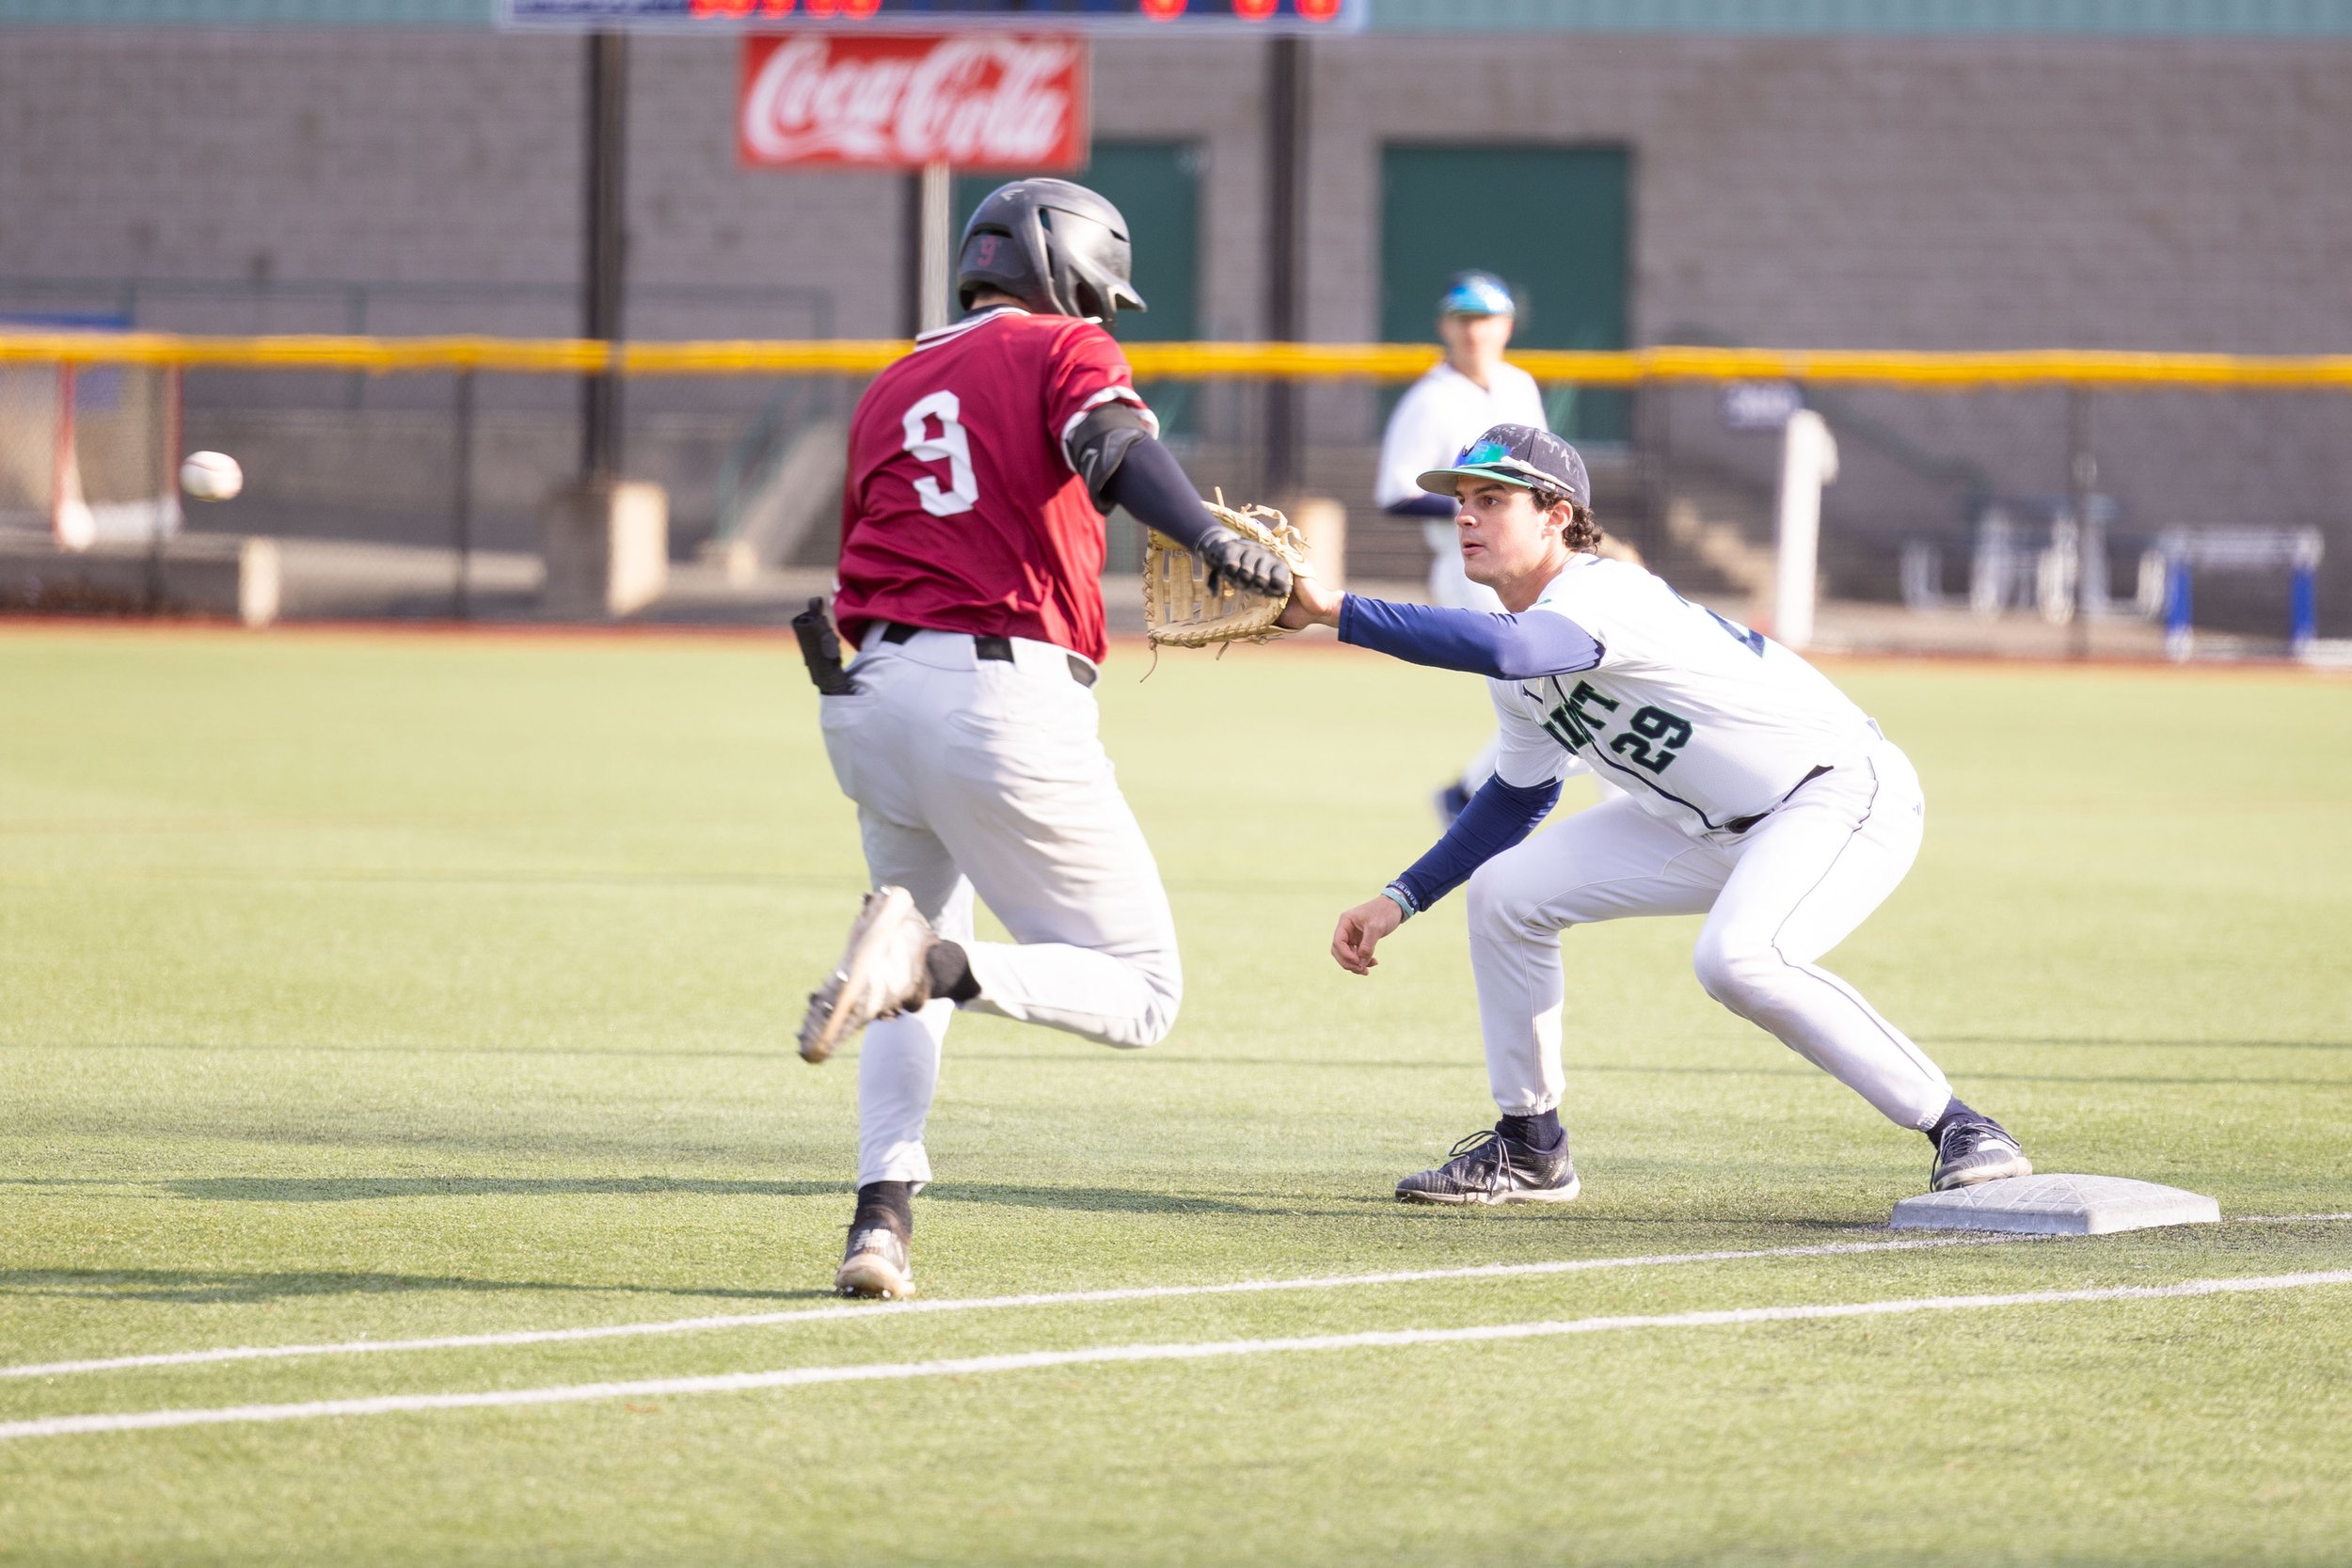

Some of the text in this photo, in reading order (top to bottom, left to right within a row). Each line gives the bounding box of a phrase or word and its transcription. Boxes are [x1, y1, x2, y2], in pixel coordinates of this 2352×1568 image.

[977, 234, 997, 267] 9
[902, 389, 979, 517] 9
[1609, 705, 1693, 776] 29
